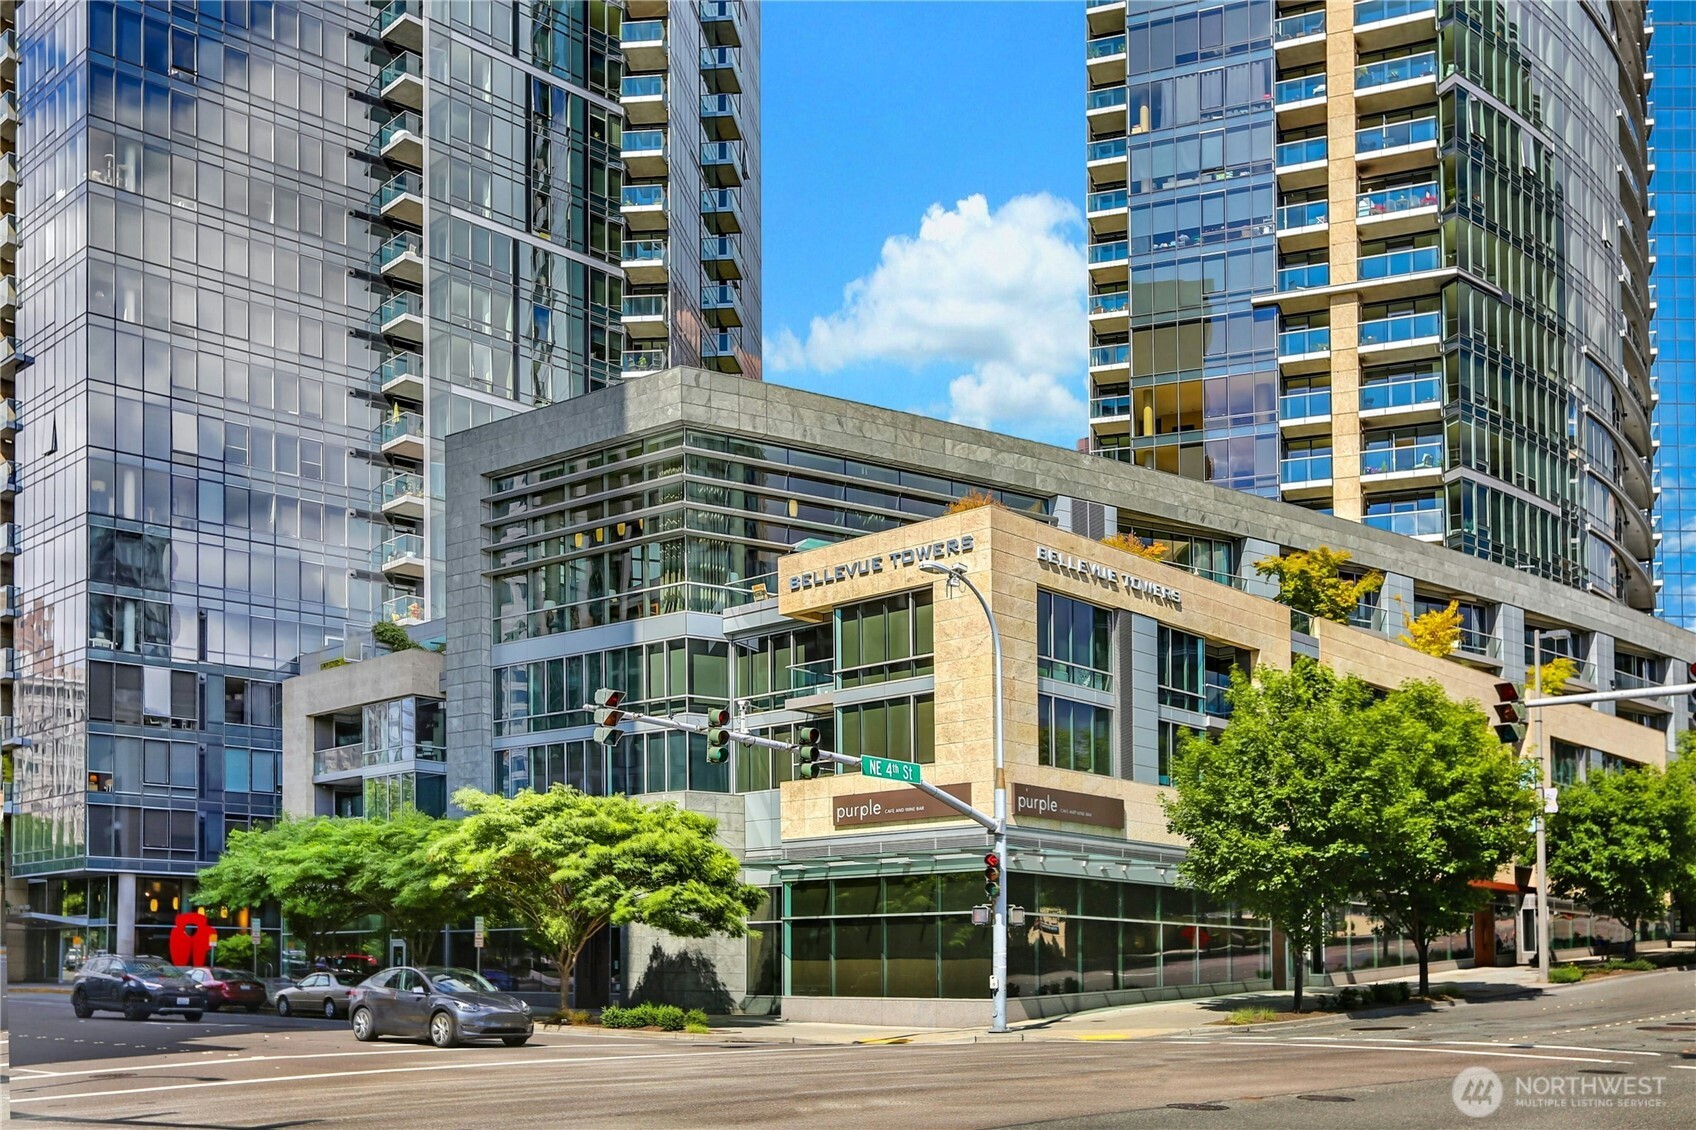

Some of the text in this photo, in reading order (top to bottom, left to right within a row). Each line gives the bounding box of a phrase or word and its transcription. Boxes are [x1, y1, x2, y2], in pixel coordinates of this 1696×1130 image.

[789, 535, 974, 592] BELLEVUE TOWERS
[1037, 545, 1181, 603] BELLEVUE TOWERS
[869, 759, 913, 780] NE 4th St
[836, 798, 881, 823] purple
[1017, 794, 1058, 815] purple
